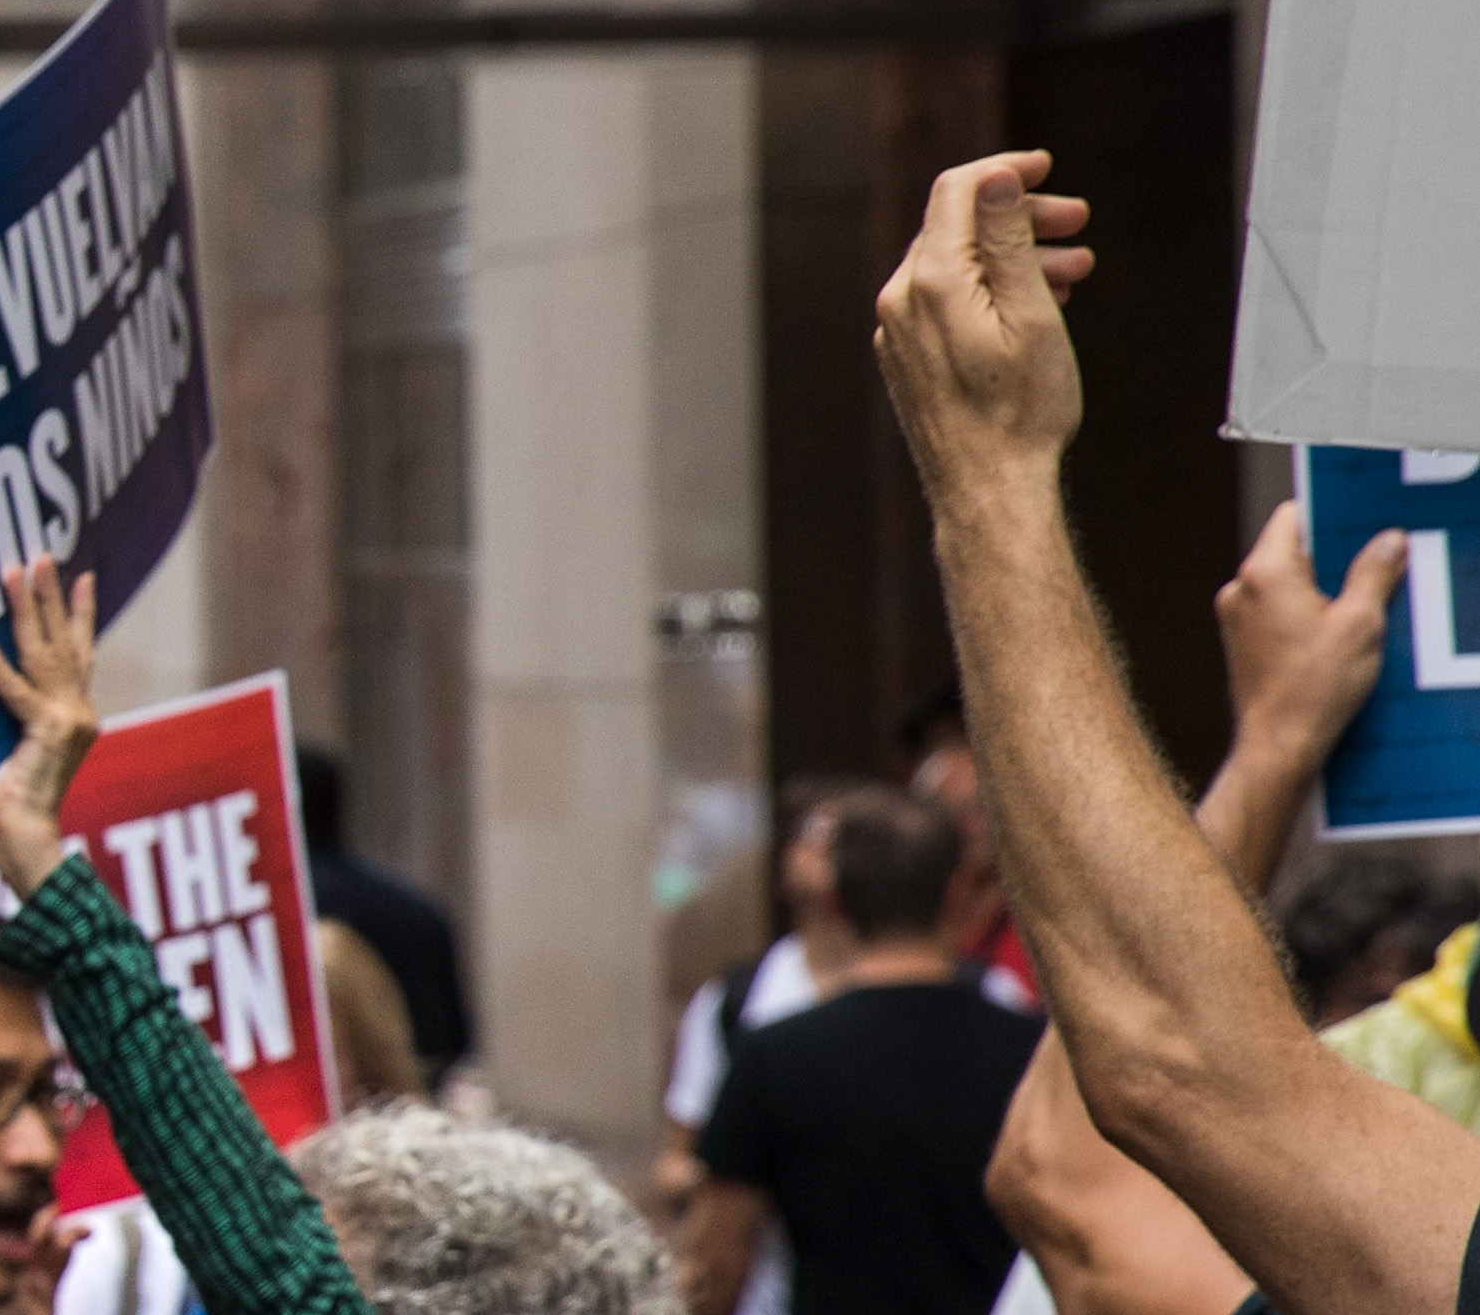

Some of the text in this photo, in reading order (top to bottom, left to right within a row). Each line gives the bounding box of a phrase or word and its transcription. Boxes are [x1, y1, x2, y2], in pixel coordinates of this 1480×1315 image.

[73, 232, 192, 520] NIÑOS
[103, 789, 271, 944] THE
[153, 913, 295, 1072] EN
